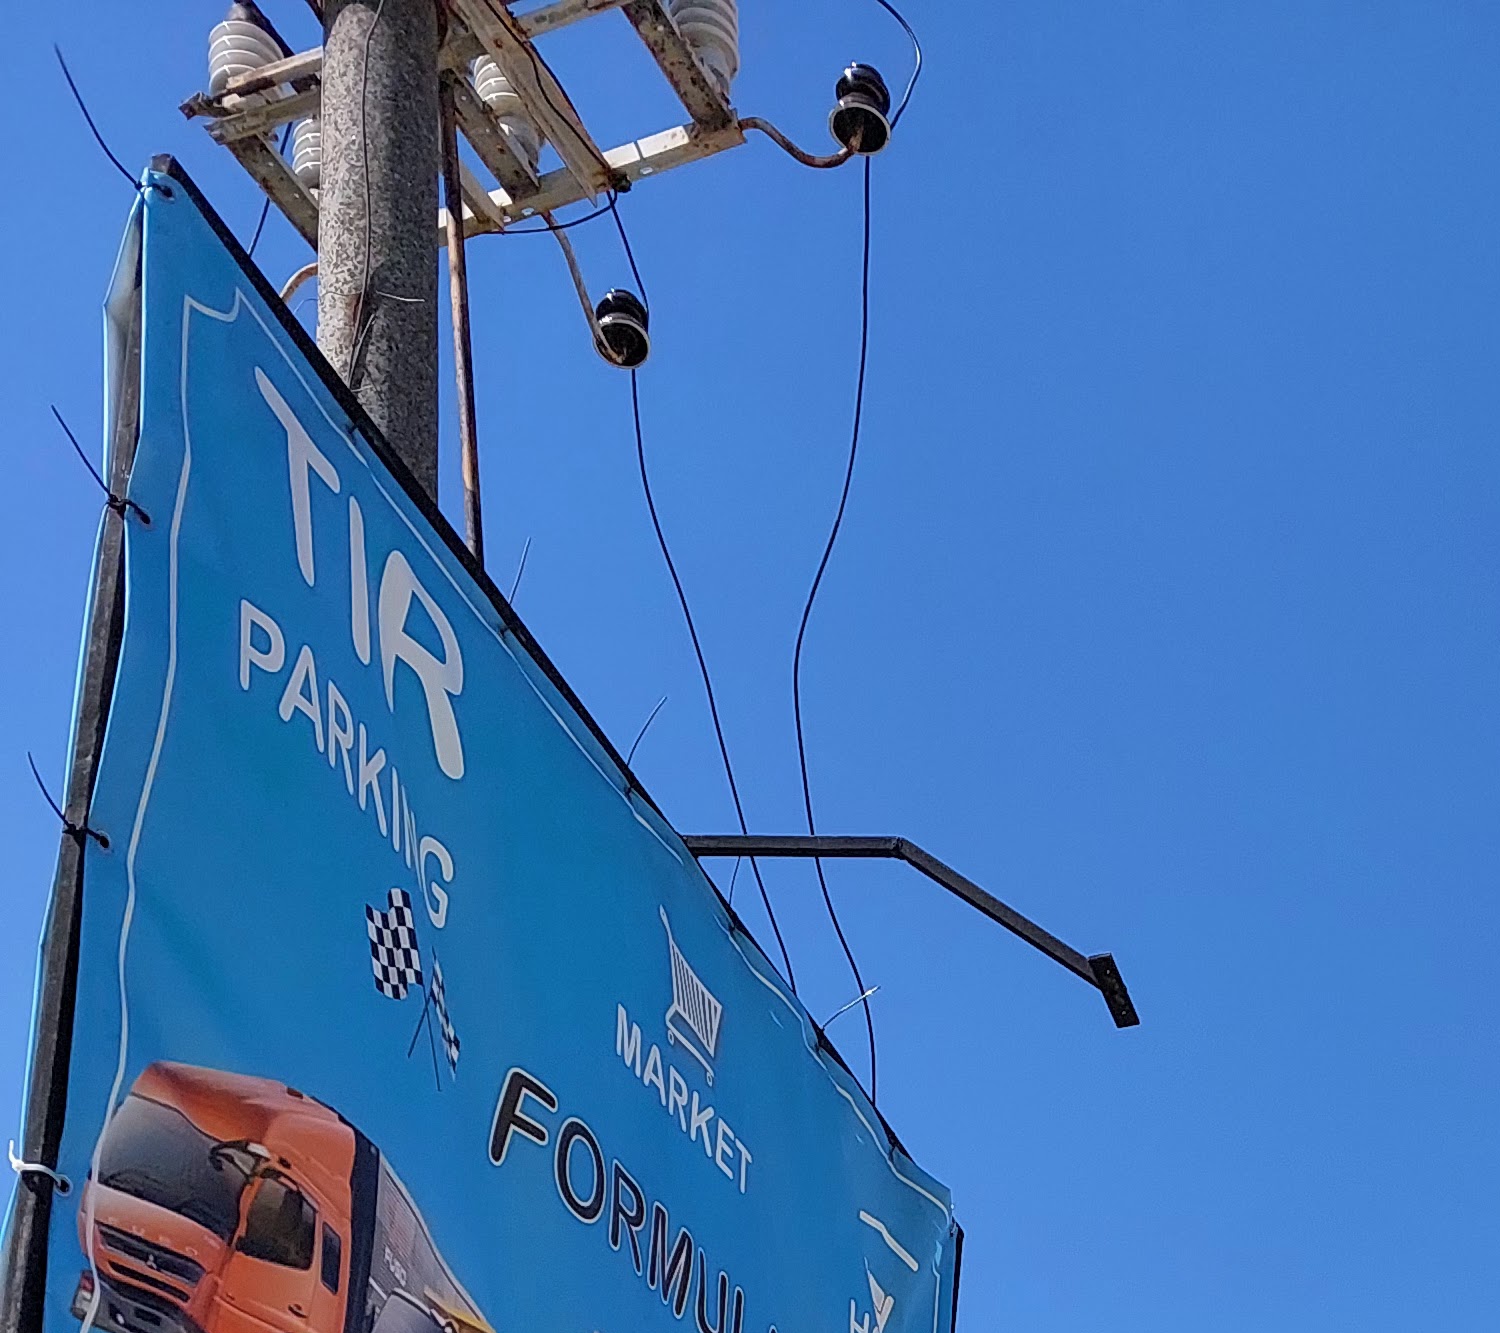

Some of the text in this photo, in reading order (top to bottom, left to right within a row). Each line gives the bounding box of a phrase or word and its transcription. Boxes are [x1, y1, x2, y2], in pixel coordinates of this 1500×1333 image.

[254, 366, 465, 780] TIR
[240, 598, 455, 930] PARKING
[615, 1002, 753, 1195] MARKET
